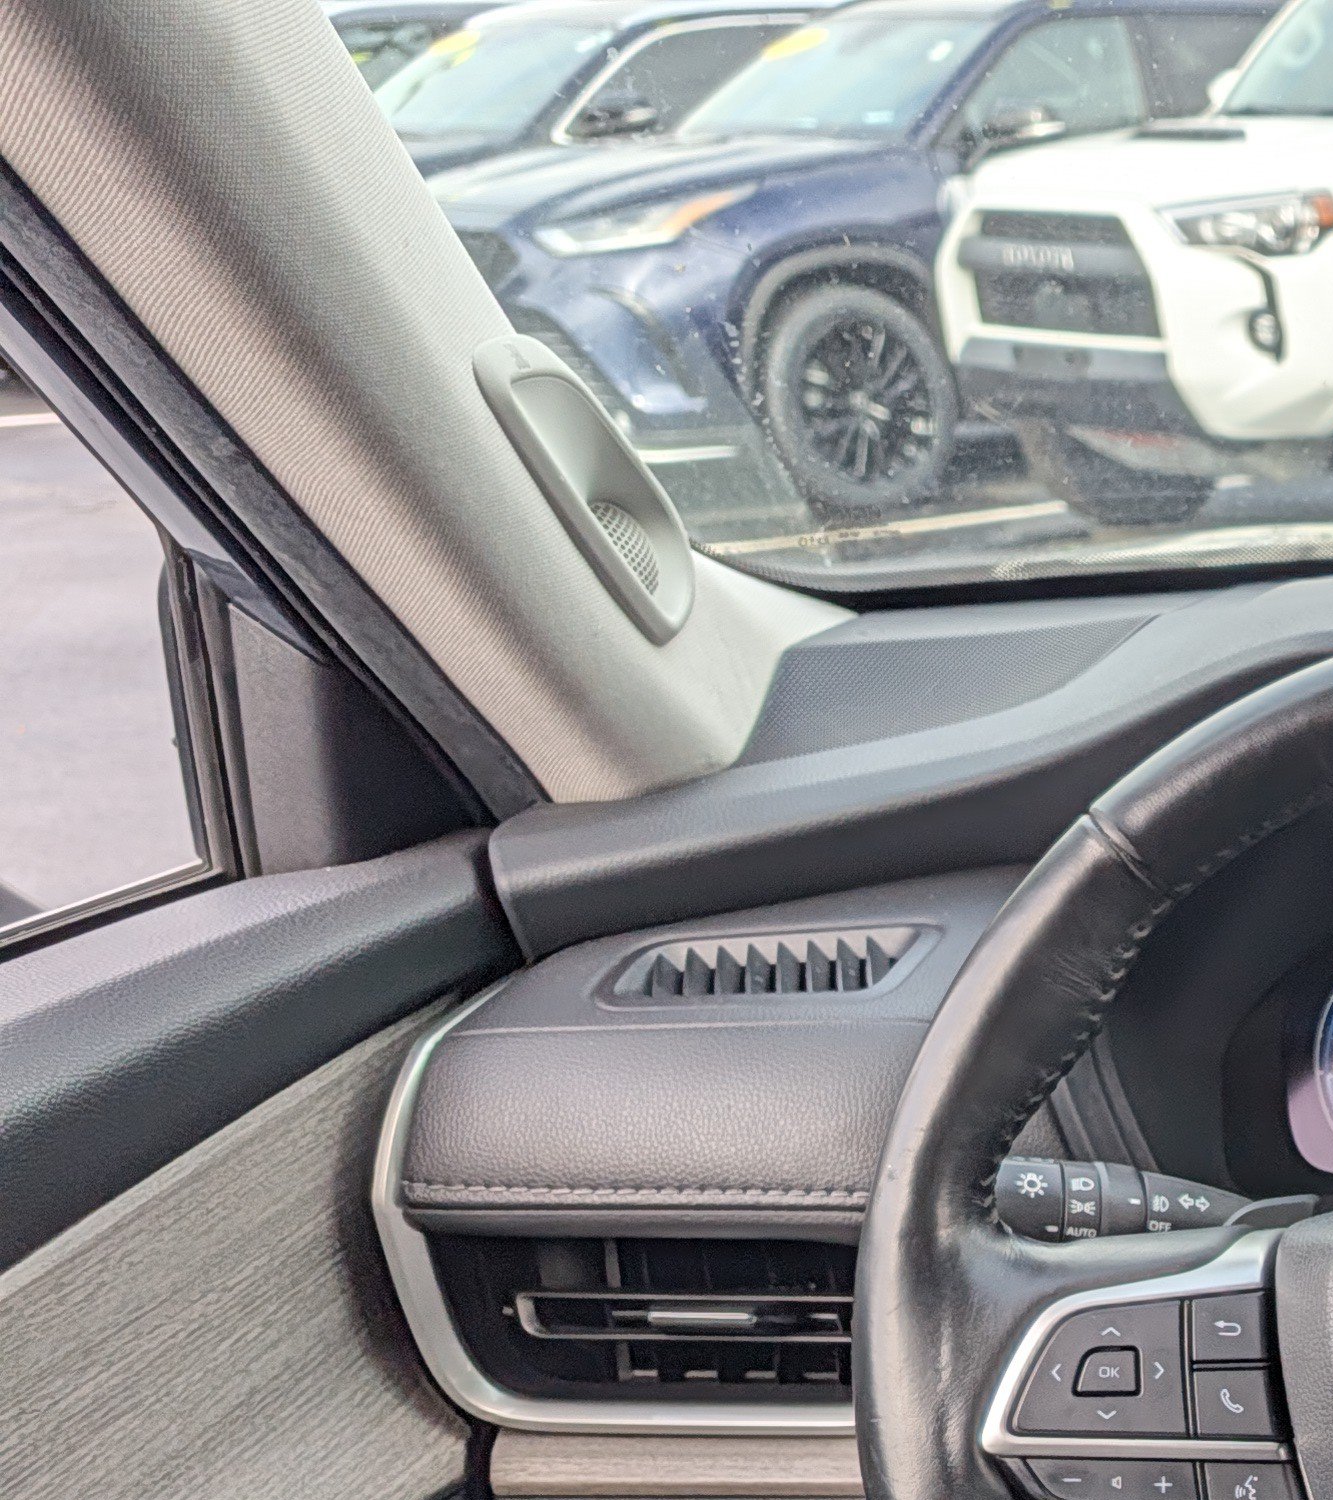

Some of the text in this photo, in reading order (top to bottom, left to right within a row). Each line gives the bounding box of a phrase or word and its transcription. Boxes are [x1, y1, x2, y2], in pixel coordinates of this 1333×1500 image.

[1066, 1225, 1097, 1239] AUTO
[1149, 1219, 1171, 1232] OFF
[1098, 1366, 1120, 1378] OK
